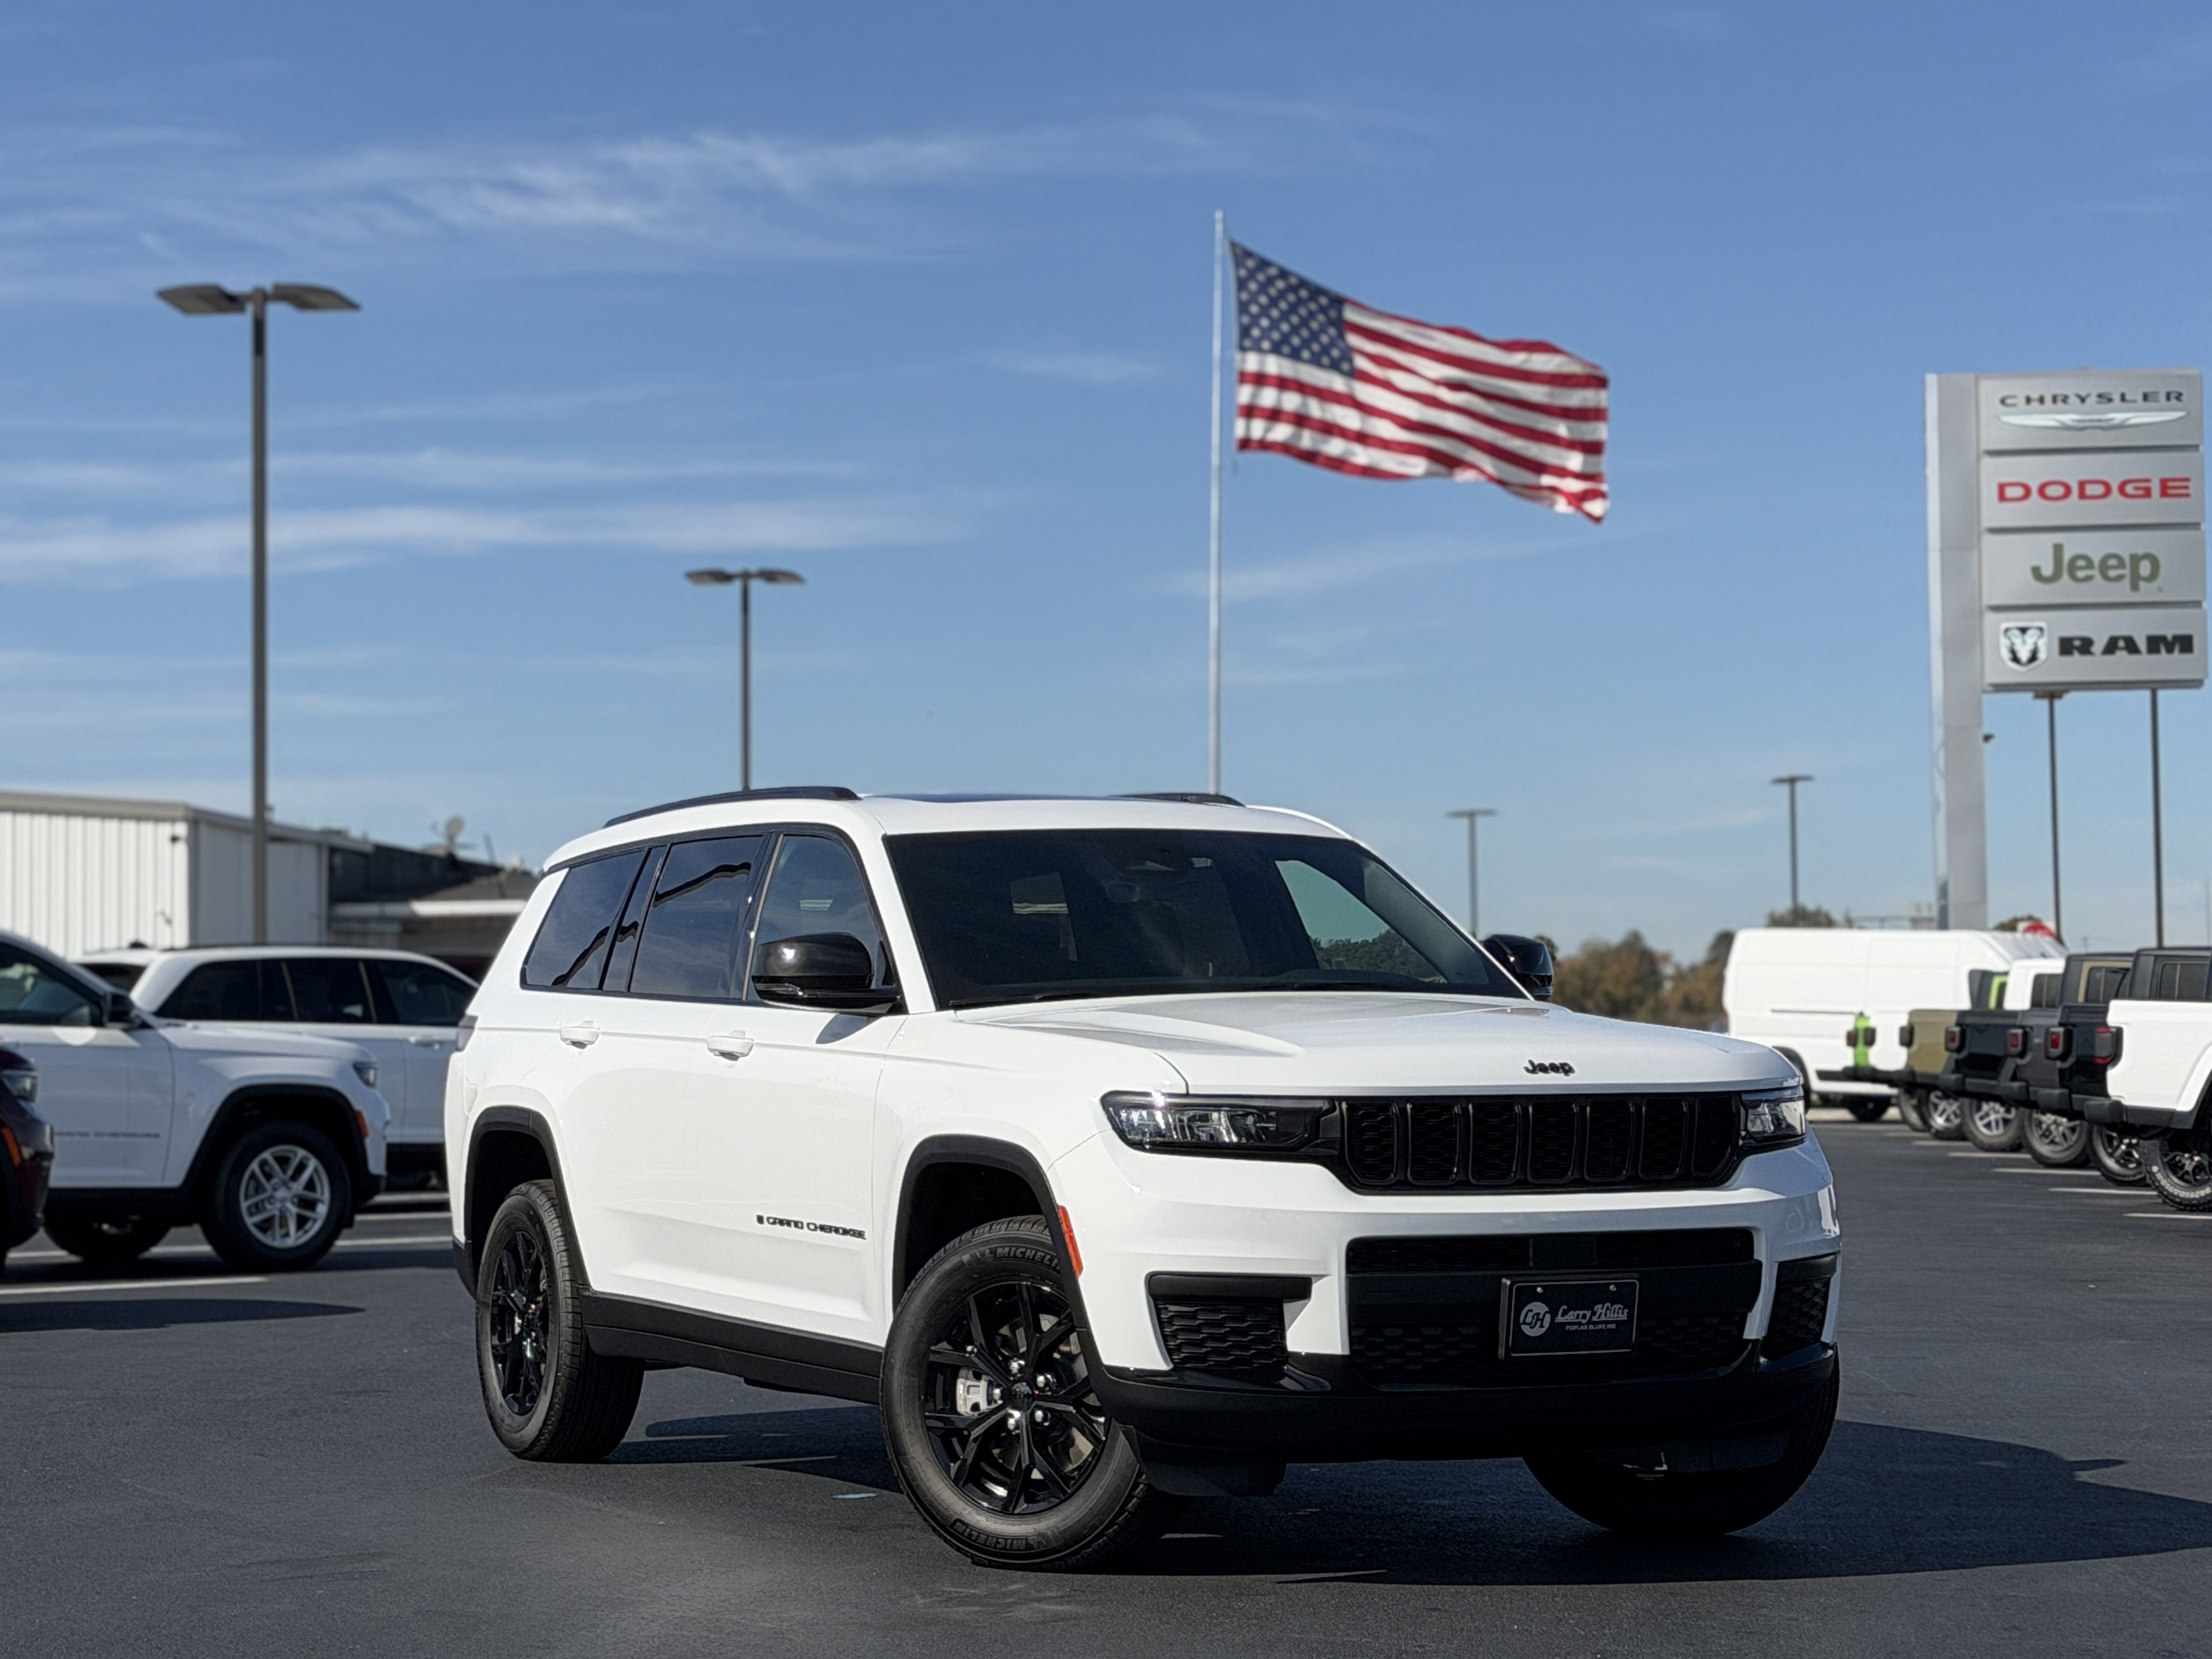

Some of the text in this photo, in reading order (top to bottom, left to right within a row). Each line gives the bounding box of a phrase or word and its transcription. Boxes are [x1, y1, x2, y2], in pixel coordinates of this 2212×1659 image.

[1999, 390, 2185, 407] CHRYSLER
[1997, 477, 2191, 503] DODGE
[2031, 543, 2160, 591] Jeep
[2058, 634, 2194, 656] RAM
[1523, 1059, 1575, 1076] Jeep
[1555, 1302, 1628, 1323] Larry Hillis
[953, 1522, 1026, 1549] MICHELIN
